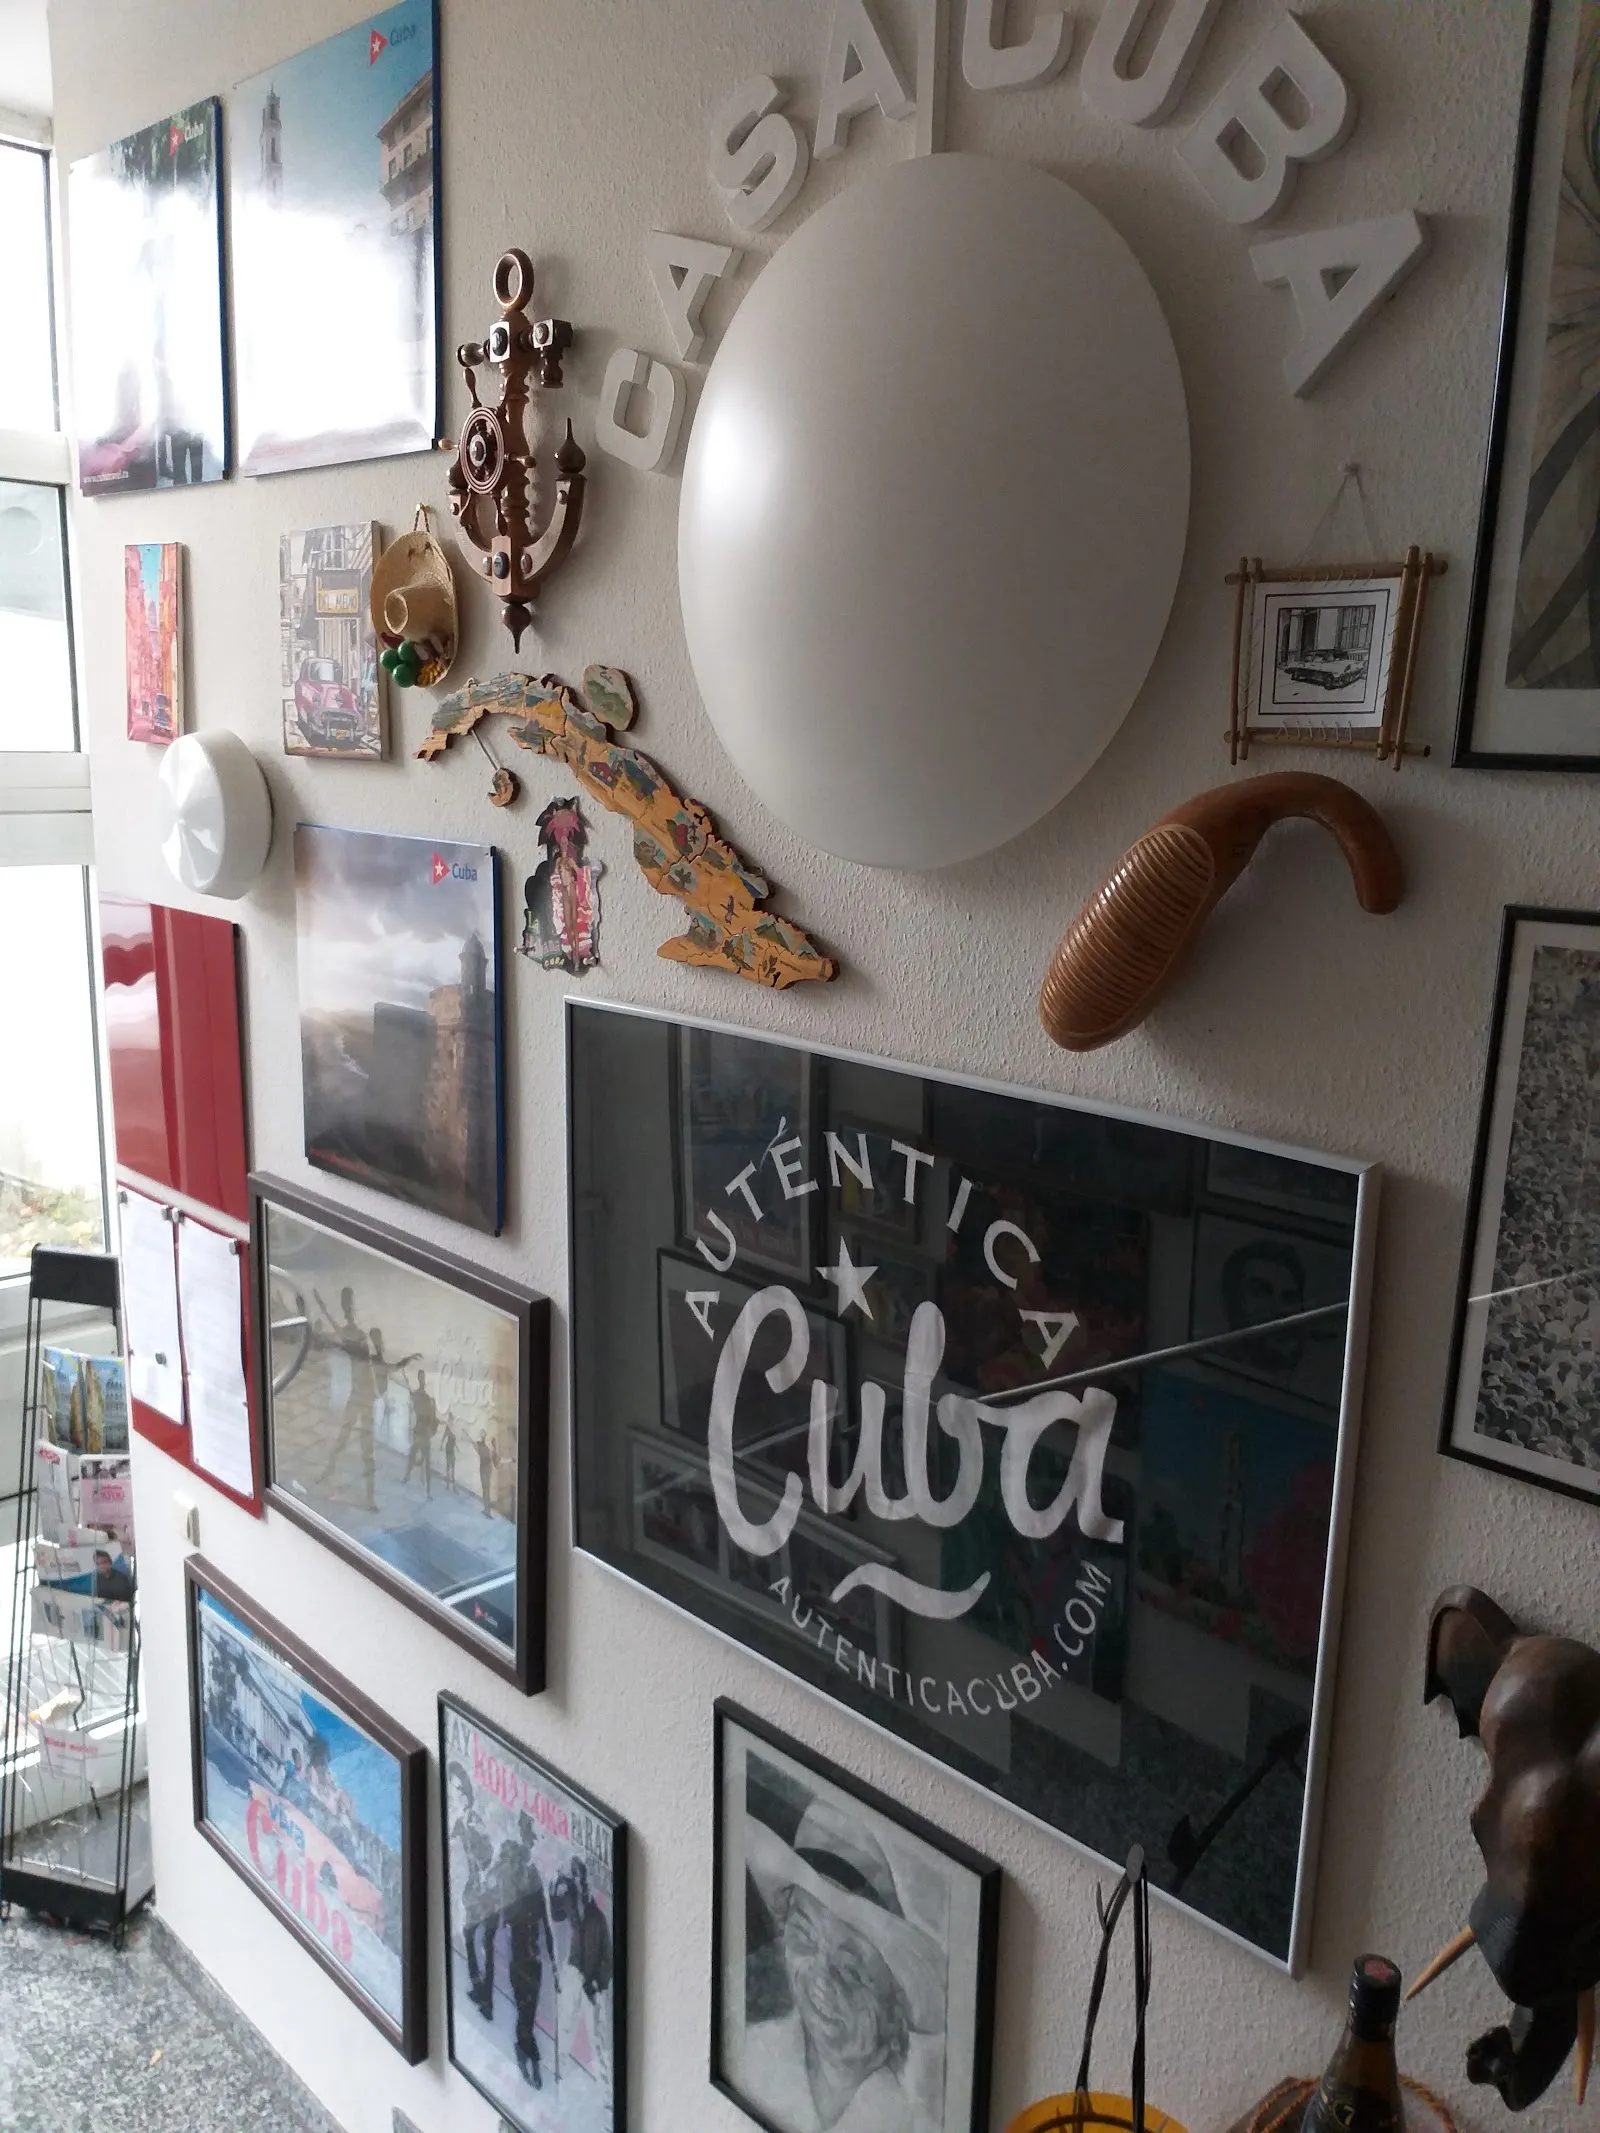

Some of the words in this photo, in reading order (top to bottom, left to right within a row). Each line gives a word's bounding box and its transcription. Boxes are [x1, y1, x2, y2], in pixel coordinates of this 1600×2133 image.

[390, 25, 416, 47] Cuba
[184, 122, 204, 143] Cuba
[600, 0, 916, 473] CASA
[451, 862, 478, 882] Cuba
[684, 1115, 1081, 1369] AUTÉNTICA
[707, 1284, 1125, 1557] Cuba
[768, 1558, 1114, 1718] AUTENTICACUBA.COM
[246, 1798, 353, 1962] Cuba
